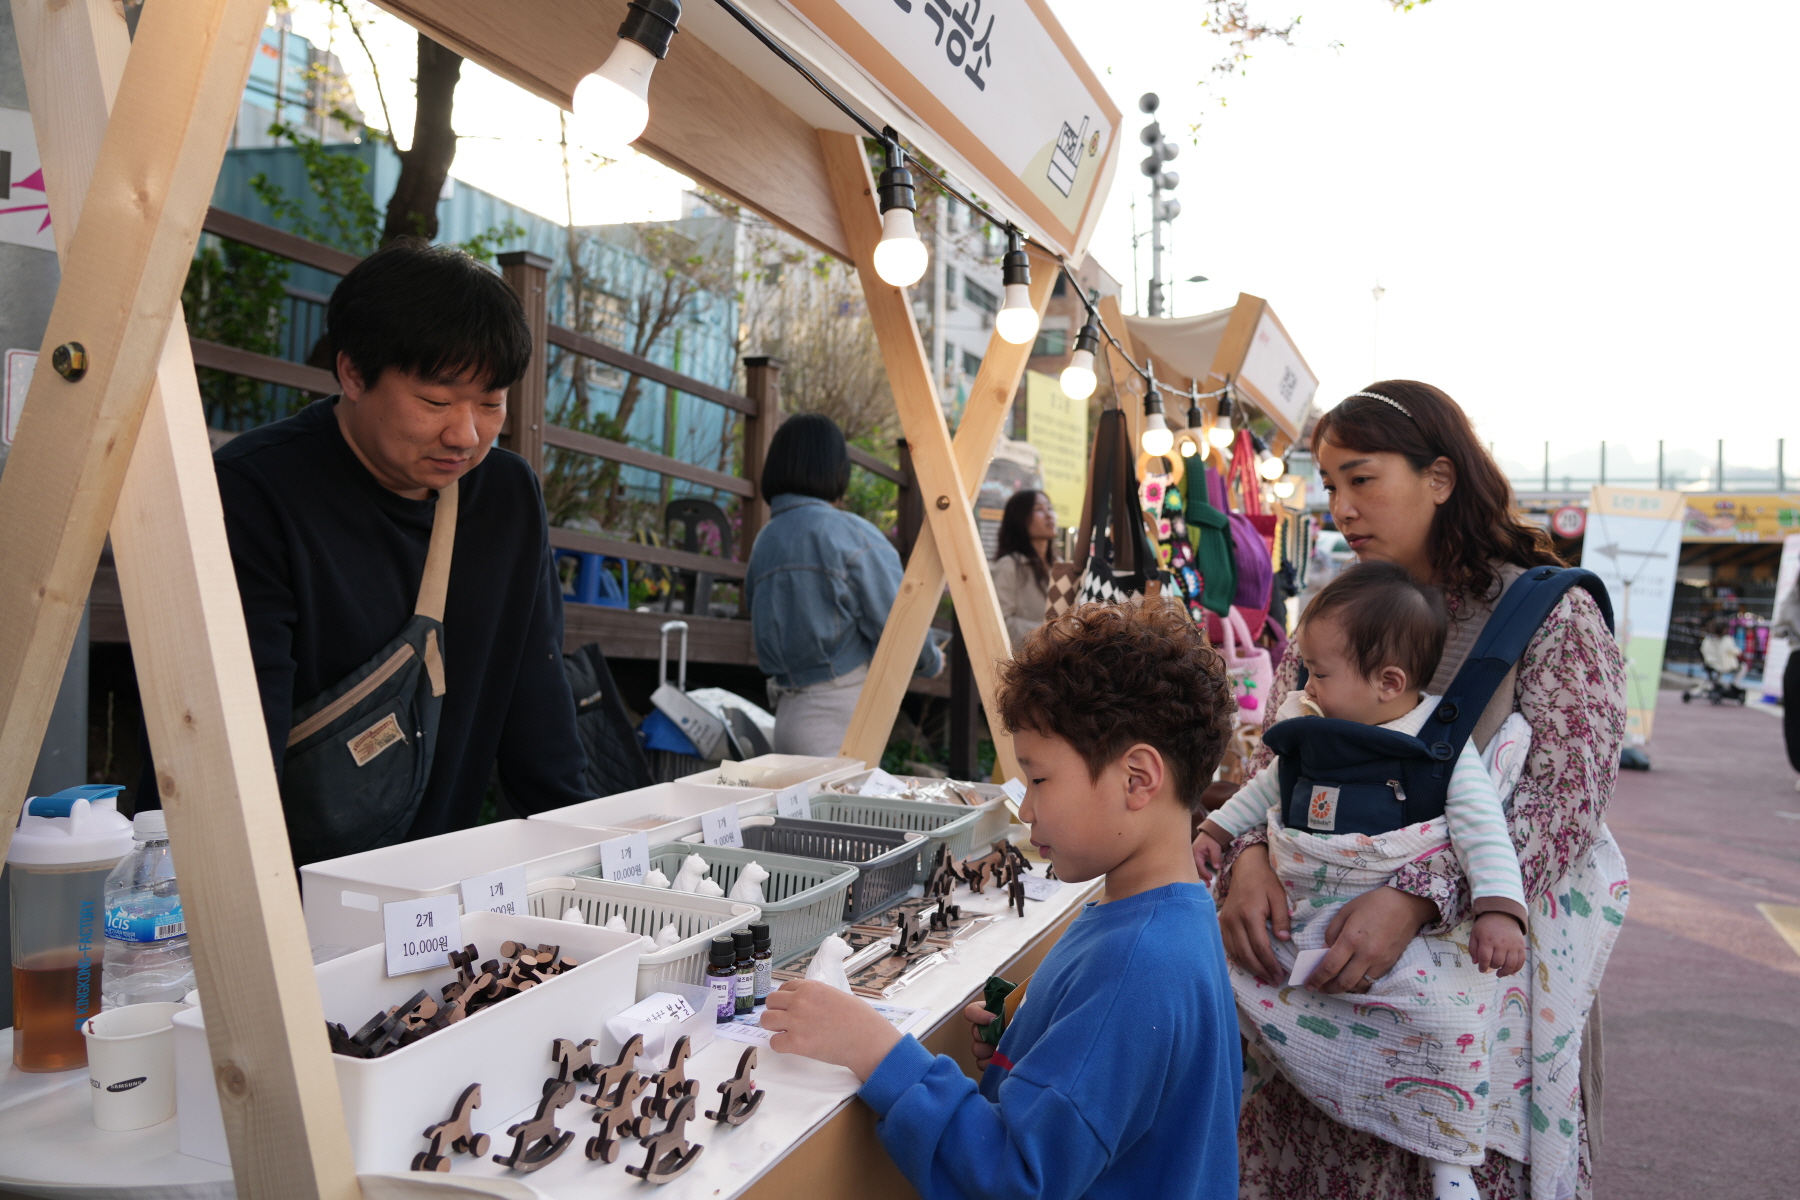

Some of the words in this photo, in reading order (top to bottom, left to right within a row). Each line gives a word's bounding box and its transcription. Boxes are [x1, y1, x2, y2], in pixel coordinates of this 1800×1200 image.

[717, 816, 727, 829] 1개
[621, 847, 632, 860] 1개
[613, 863, 642, 882] 10,000원
[490, 882, 504, 897] 1개
[415, 911, 434, 928] 2개
[402, 935, 448, 957] 10,000원
[110, 1080, 143, 1090] SAMSUNG
